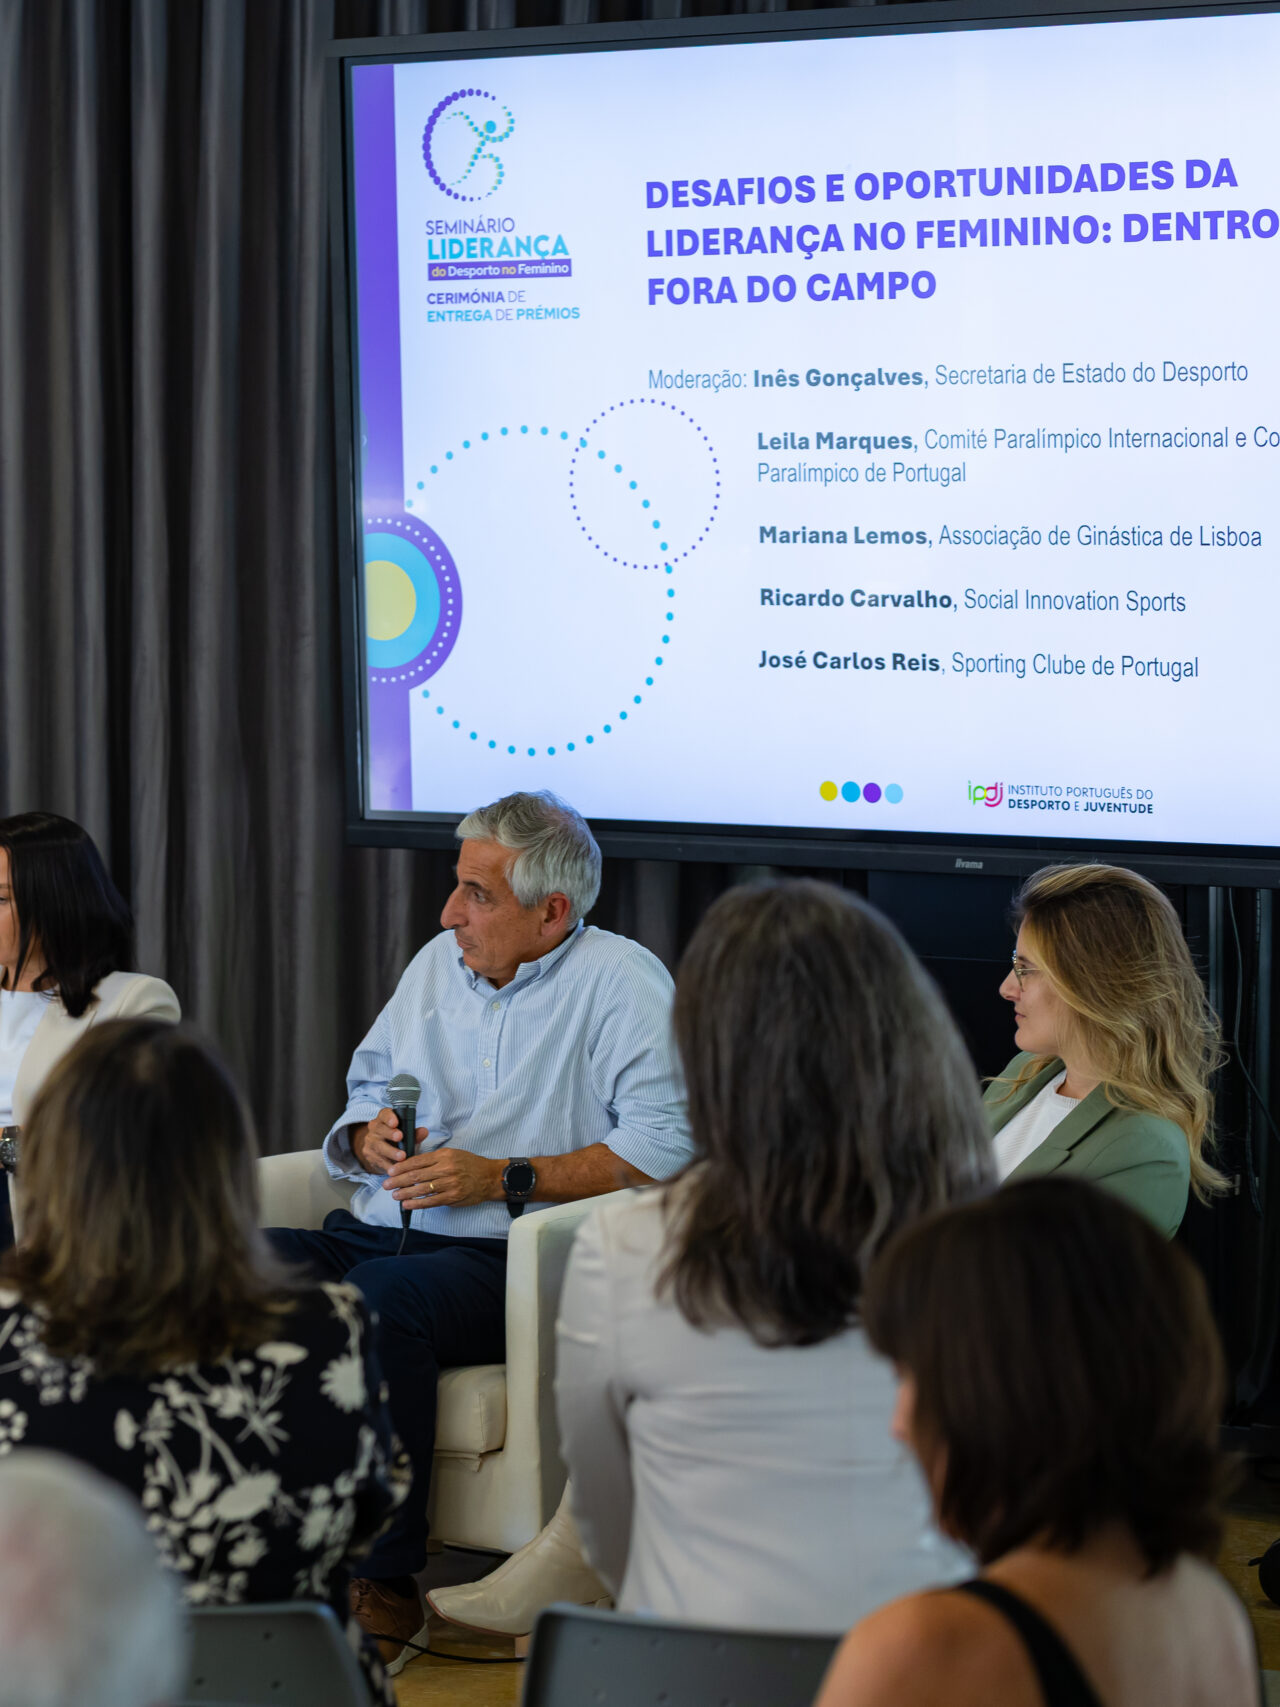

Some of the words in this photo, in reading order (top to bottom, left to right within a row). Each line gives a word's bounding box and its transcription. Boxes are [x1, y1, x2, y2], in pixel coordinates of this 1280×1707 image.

[646, 175, 816, 208] DESAFIOS
[826, 174, 844, 202] E
[855, 161, 1174, 201] OPORTUNIDADES
[1186, 158, 1238, 188] DA
[426, 215, 515, 235] SEMINÁRIO
[647, 224, 844, 260] LIDERANÇA
[854, 222, 905, 251] NO
[917, 215, 1111, 249] FEMININO:
[1124, 209, 1279, 242] DENTRO
[428, 234, 569, 260] LIDERANÇA
[432, 265, 446, 277] do
[448, 264, 500, 279] Desporto
[502, 266, 516, 275] no
[518, 262, 569, 274] Feminino
[427, 289, 505, 304] CERIMÓNIA
[508, 290, 526, 302] DE
[648, 276, 738, 305] FORA
[747, 275, 796, 303] DO
[807, 271, 936, 301] CAMPO
[427, 310, 492, 322] ENTREGA
[496, 309, 513, 321] DE
[516, 305, 580, 320] PRÉMIOS
[649, 369, 746, 393] Moderação:
[754, 369, 799, 387] Inês
[806, 368, 928, 391] Gonçalves,
[936, 364, 1026, 385] Secretaria
[1033, 363, 1055, 383] de
[1063, 362, 1125, 383] Estado
[1133, 362, 1155, 382] do
[1163, 361, 1248, 386] Desporto
[758, 432, 809, 450] Leila
[816, 432, 917, 454] Marques,
[925, 429, 987, 449] Comité
[995, 428, 1101, 453] Paralímpico
[1109, 427, 1228, 448] Internacional
[1235, 431, 1247, 448] e
[758, 463, 859, 487] Paralímpico
[865, 462, 886, 482] de
[893, 462, 965, 487] Portugal
[760, 526, 847, 544] Mariana
[854, 526, 932, 548] Lemos,
[939, 525, 1041, 550] Associação
[1048, 525, 1070, 545] de
[1078, 525, 1163, 546] Ginástica
[1170, 526, 1192, 546] de
[1200, 526, 1261, 546] Lisboa
[761, 588, 844, 606] Ricardo
[851, 589, 957, 612] Carvalho,
[965, 588, 1018, 609] Social
[1026, 589, 1118, 610] Innovation
[1127, 590, 1186, 616] Sports
[758, 650, 807, 669] José
[813, 651, 885, 670] Carlos
[892, 653, 946, 675] Reis,
[952, 652, 1025, 678] Sporting
[1033, 654, 1085, 675] Clube
[1092, 655, 1114, 675] de
[1122, 656, 1198, 682] Portugal
[968, 780, 1003, 808] ipdj
[1008, 785, 1062, 796] INSTITUTO
[1066, 787, 1132, 799] PORTUGUÊS
[1137, 789, 1153, 800] DO
[1009, 799, 1070, 810] DESPORTO
[1074, 800, 1080, 812] E
[1084, 802, 1153, 814] JUVENTUDE
